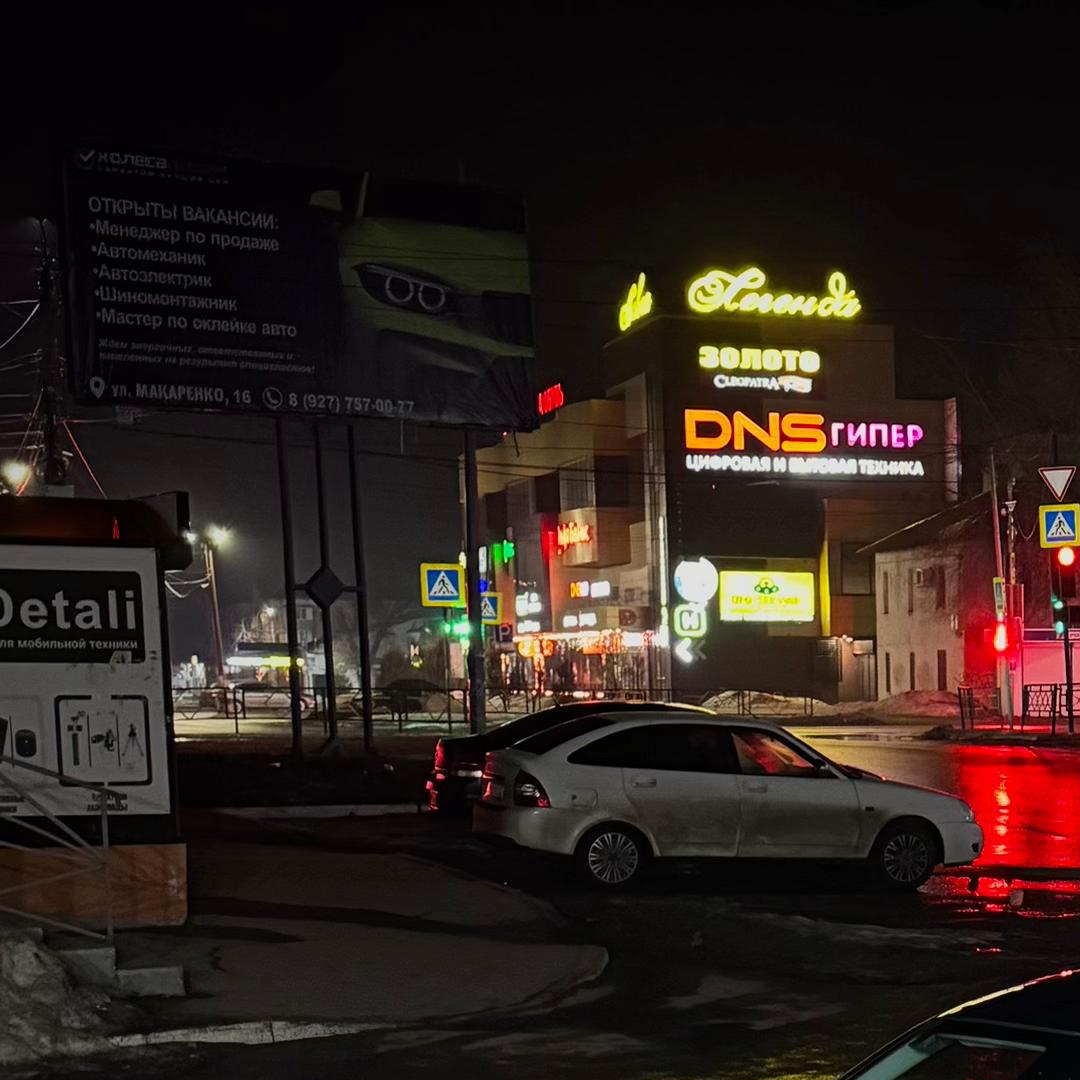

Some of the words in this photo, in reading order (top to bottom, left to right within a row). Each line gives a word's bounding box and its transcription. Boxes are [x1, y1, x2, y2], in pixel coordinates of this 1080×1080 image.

[88, 196, 178, 220] ОТКРЫТЫ
[182, 205, 280, 230] ВАКАНСИИ:
[185, 231, 206, 244] по
[211, 232, 280, 252] продаже
[167, 316, 188, 329] по
[192, 317, 257, 335] оклейке
[261, 323, 297, 337] авто
[699, 346, 822, 373] ЗОЛОТО
[111, 384, 132, 398] ул.
[135, 383, 230, 406] МАКАРЕНКО,
[233, 389, 251, 404] 16
[288, 392, 299, 408] 8
[303, 392, 341, 413] (927)
[344, 396, 415, 413] 757-00-77
[684, 409, 827, 453] DNS
[831, 422, 924, 448] ГИПЕР
[686, 454, 771, 473] ЦИФРОВАЯ
[773, 456, 787, 473] И
[859, 459, 924, 476] ТЕХНИКА
[18, 637, 87, 649] мобильной
[91, 638, 138, 649] техники
